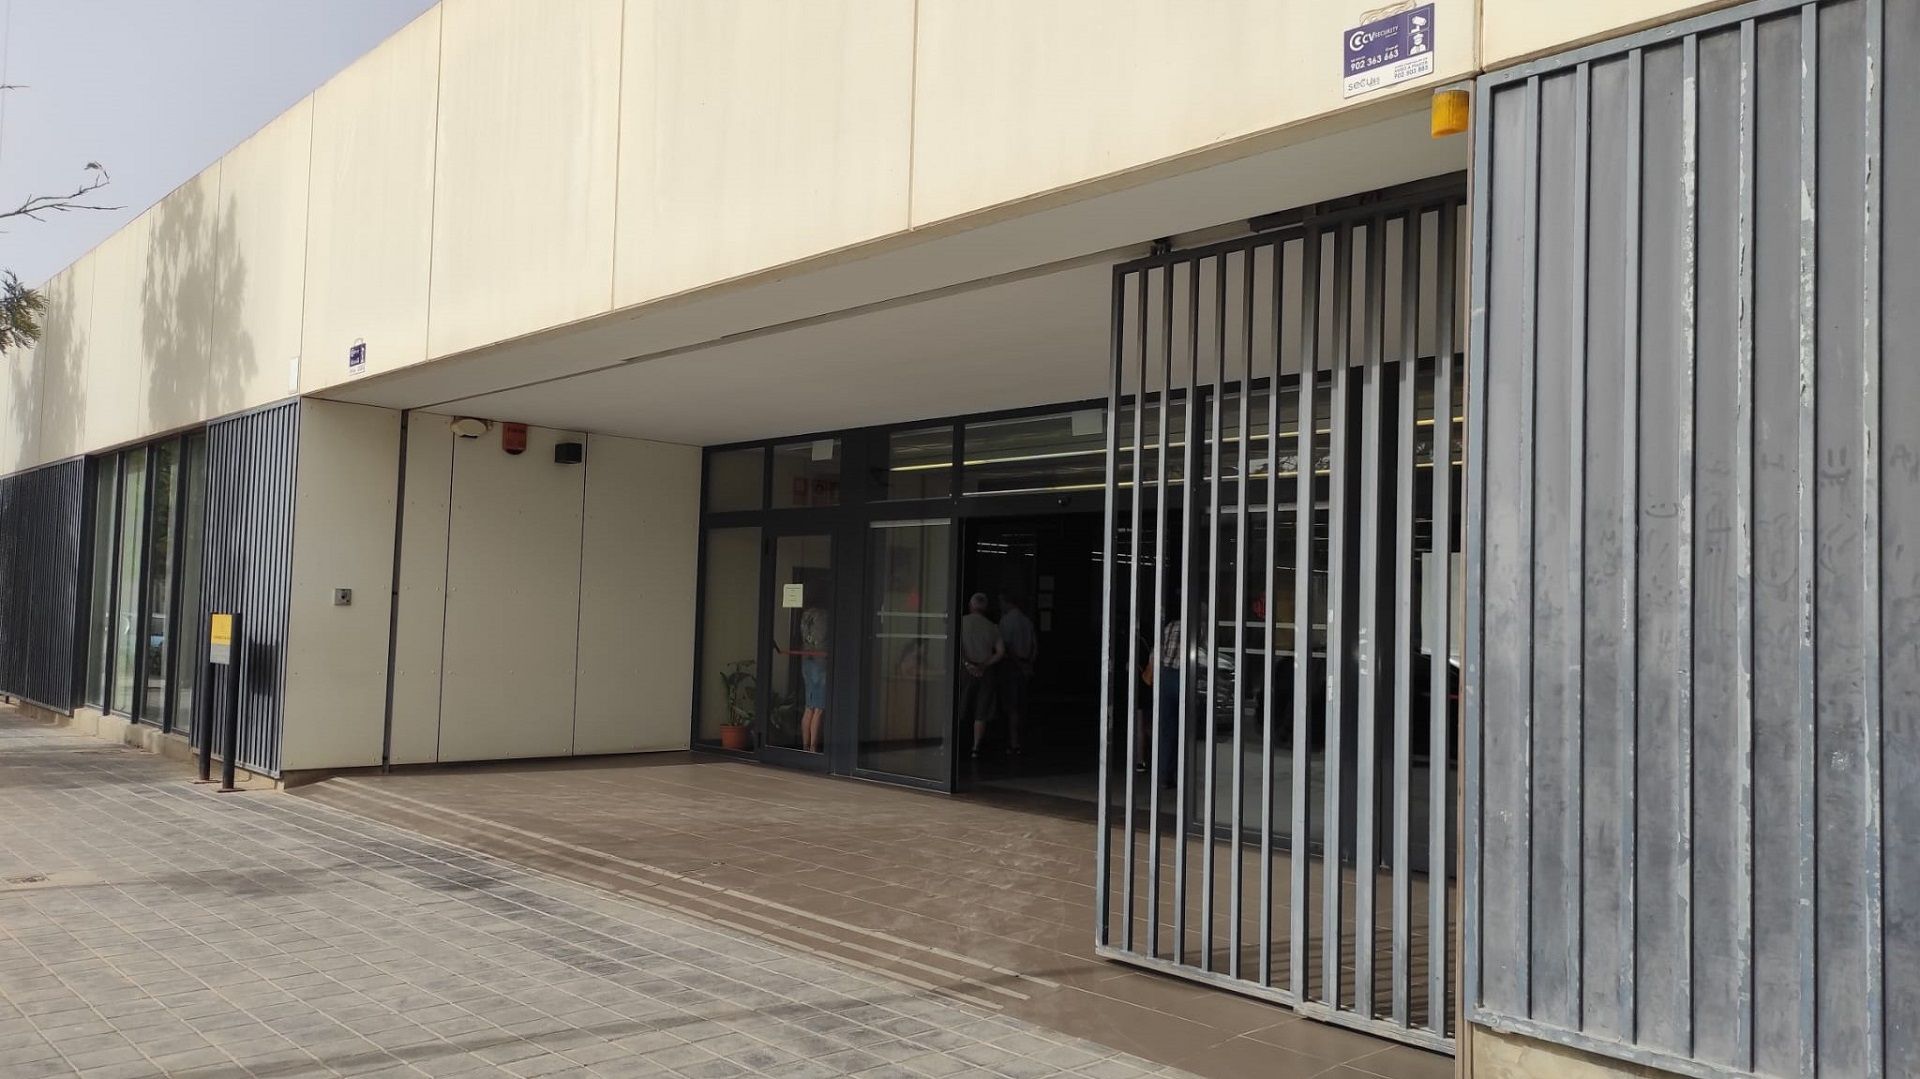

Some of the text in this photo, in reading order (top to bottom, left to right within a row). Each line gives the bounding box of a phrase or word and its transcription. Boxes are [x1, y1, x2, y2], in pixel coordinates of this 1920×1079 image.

[1350, 59, 1366, 71] 902
[1366, 54, 1382, 67] 363
[1384, 48, 1399, 61] 663
